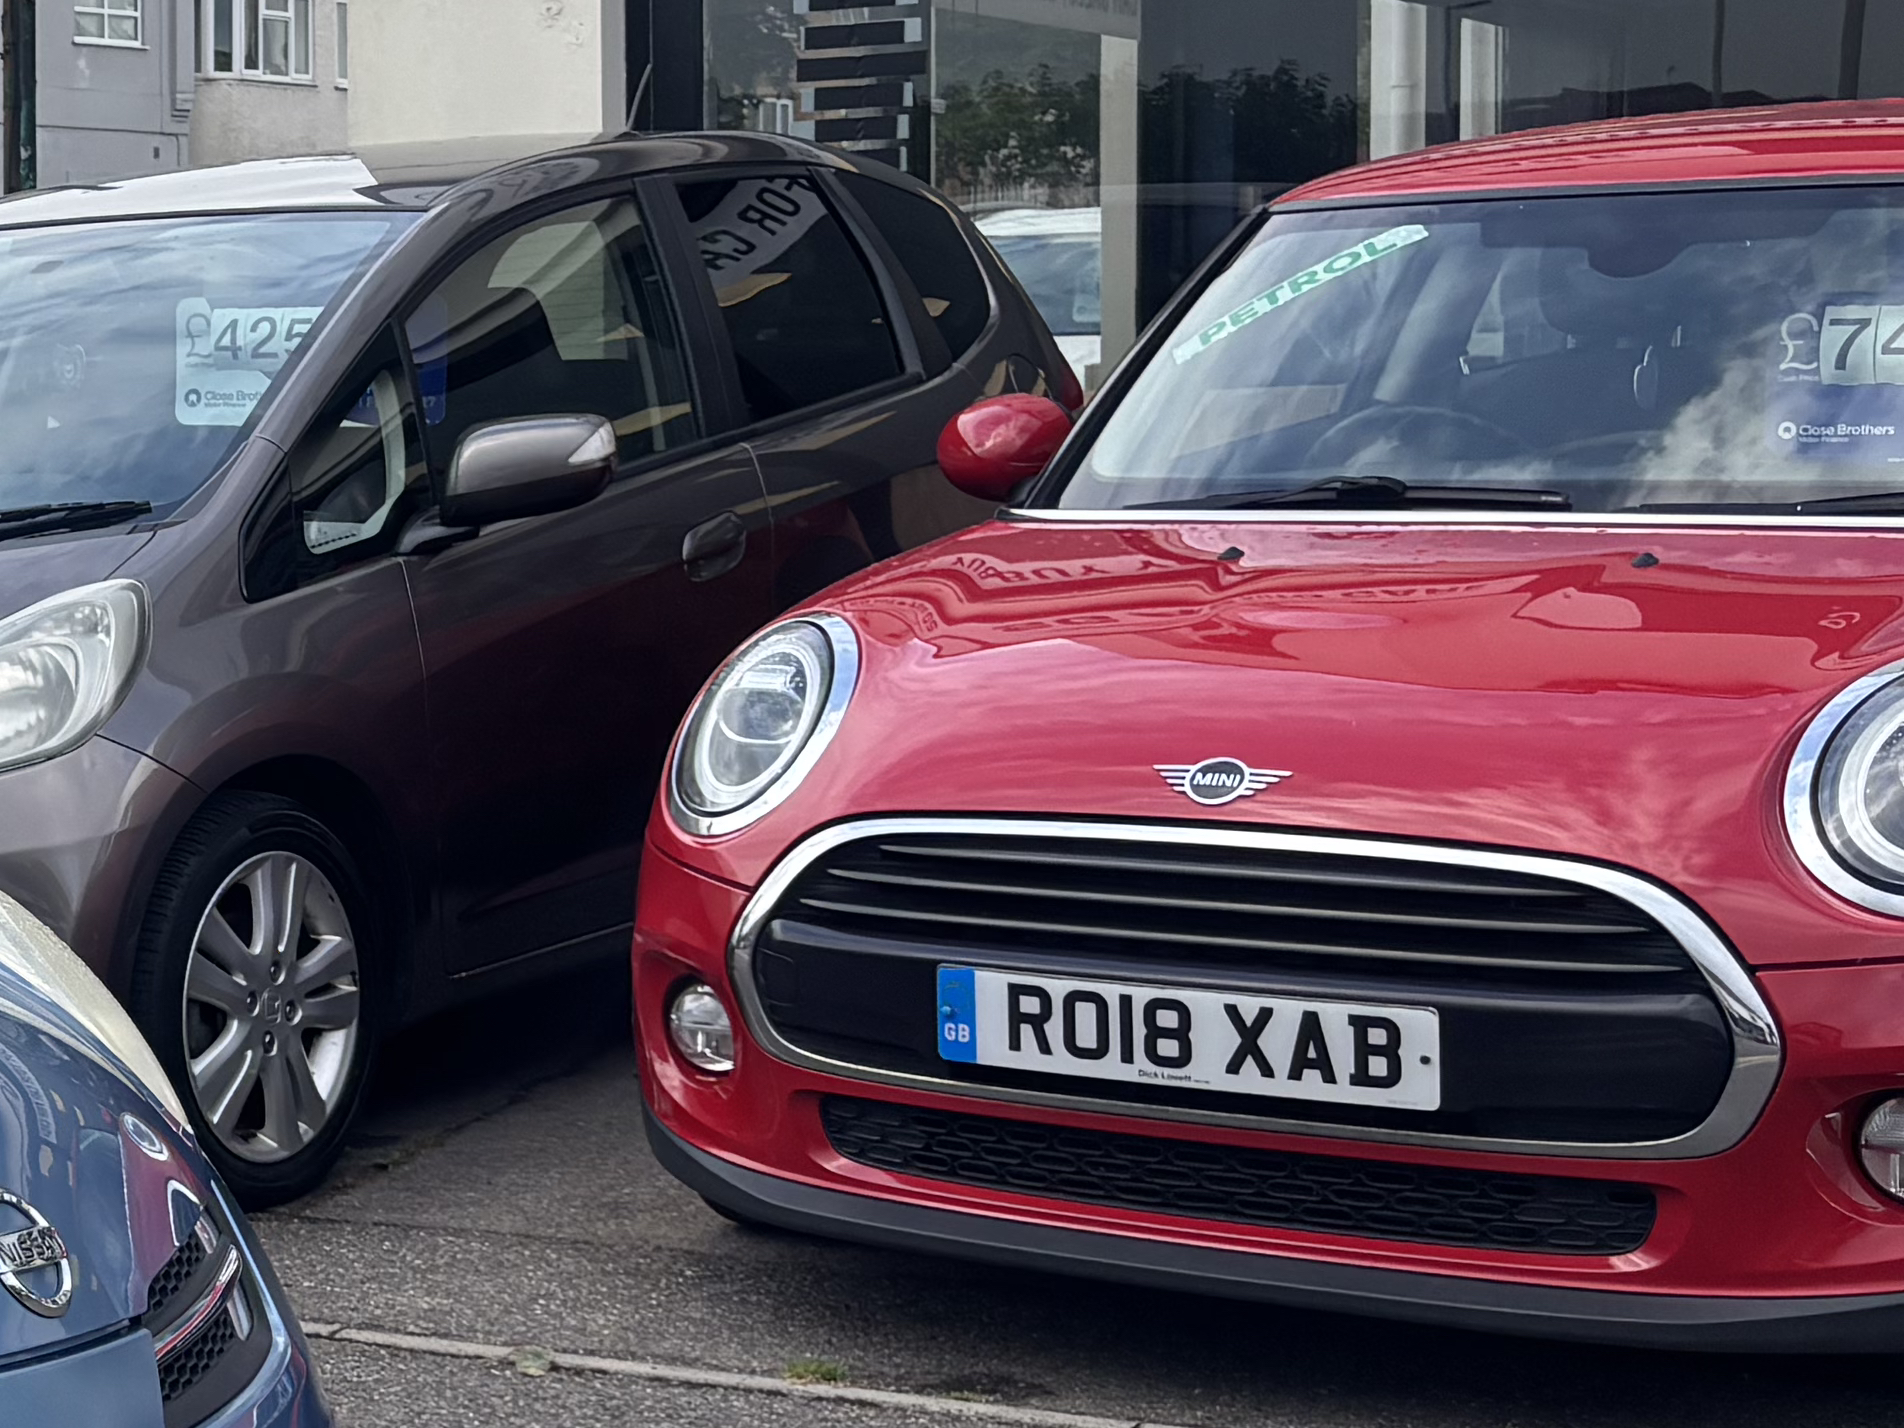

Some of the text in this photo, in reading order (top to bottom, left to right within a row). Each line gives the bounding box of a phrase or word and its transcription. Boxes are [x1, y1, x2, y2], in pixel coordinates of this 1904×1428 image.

[1199, 242, 1397, 346] PETROL
[204, 391, 234, 401] Close
[1799, 423, 1895, 435] Close Brothers
[1193, 772, 1241, 787] MINI
[944, 1023, 970, 1043] GB
[1007, 982, 1403, 1090] RO18 XAB
